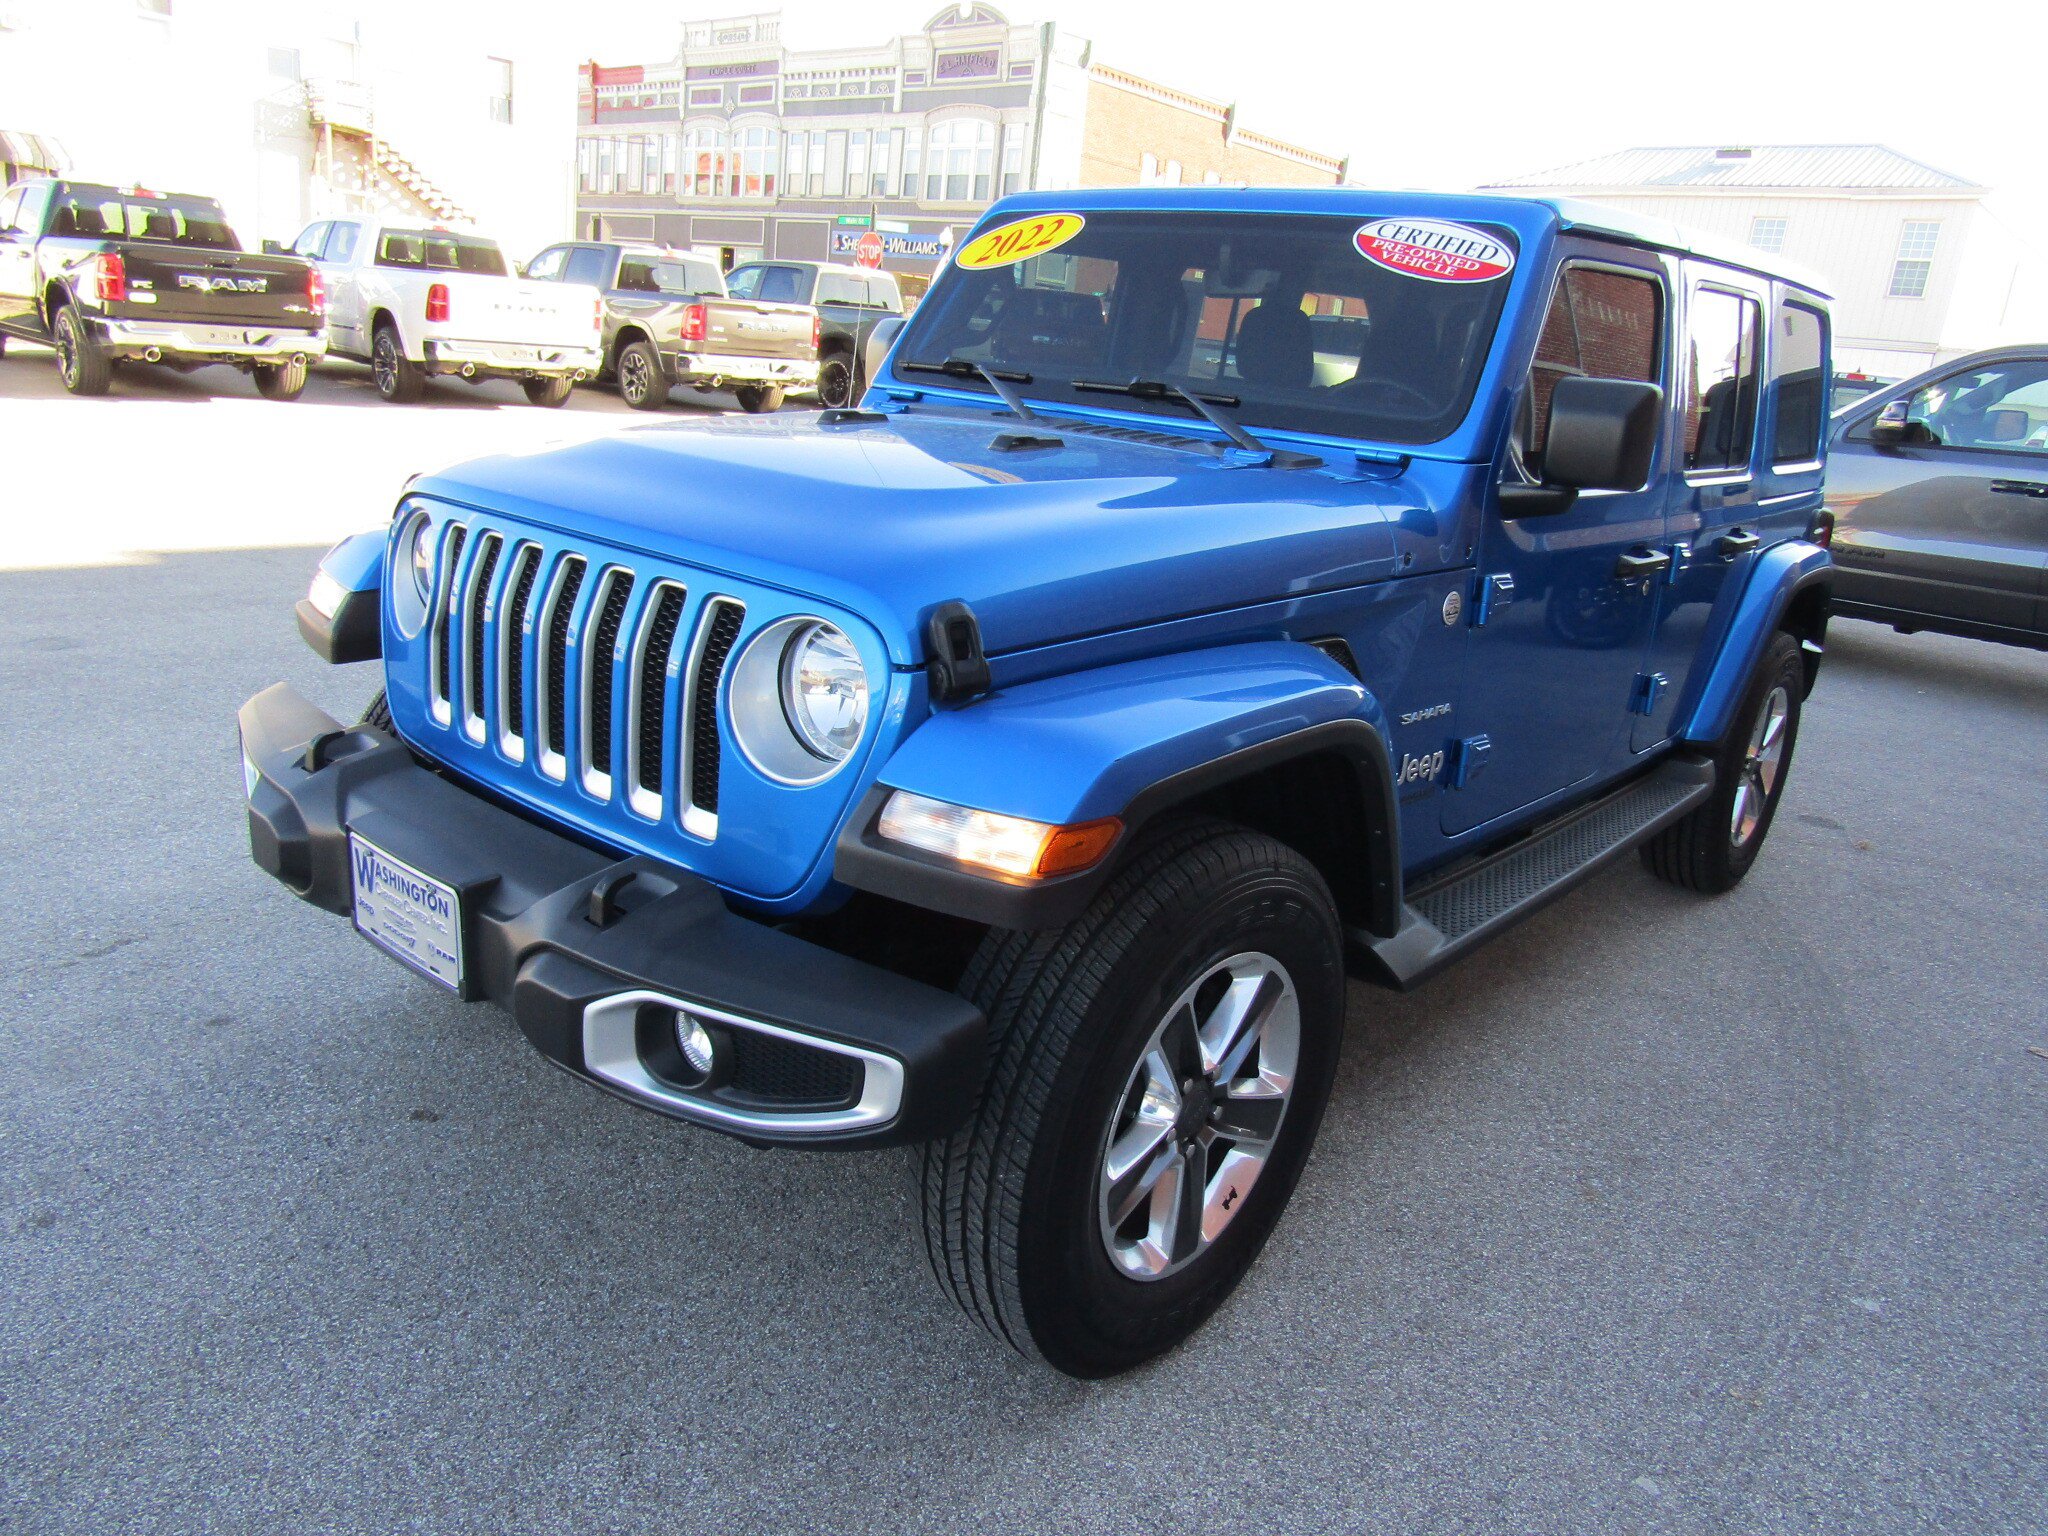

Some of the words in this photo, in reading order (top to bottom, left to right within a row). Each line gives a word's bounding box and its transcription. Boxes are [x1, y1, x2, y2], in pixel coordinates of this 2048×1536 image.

[954, 53, 995, 68] HATFIELD
[860, 245, 880, 260] STOP
[974, 218, 1064, 264] 2022
[1371, 239, 1480, 271] PRE-OWNED
[1377, 223, 1498, 261] CERTIFIED
[1381, 250, 1459, 277] VEHICLE
[178, 275, 268, 293] RAM
[1399, 703, 1452, 725] SAHARA
[1397, 750, 1444, 786] Jeep
[354, 846, 449, 918] WASHINGTON
